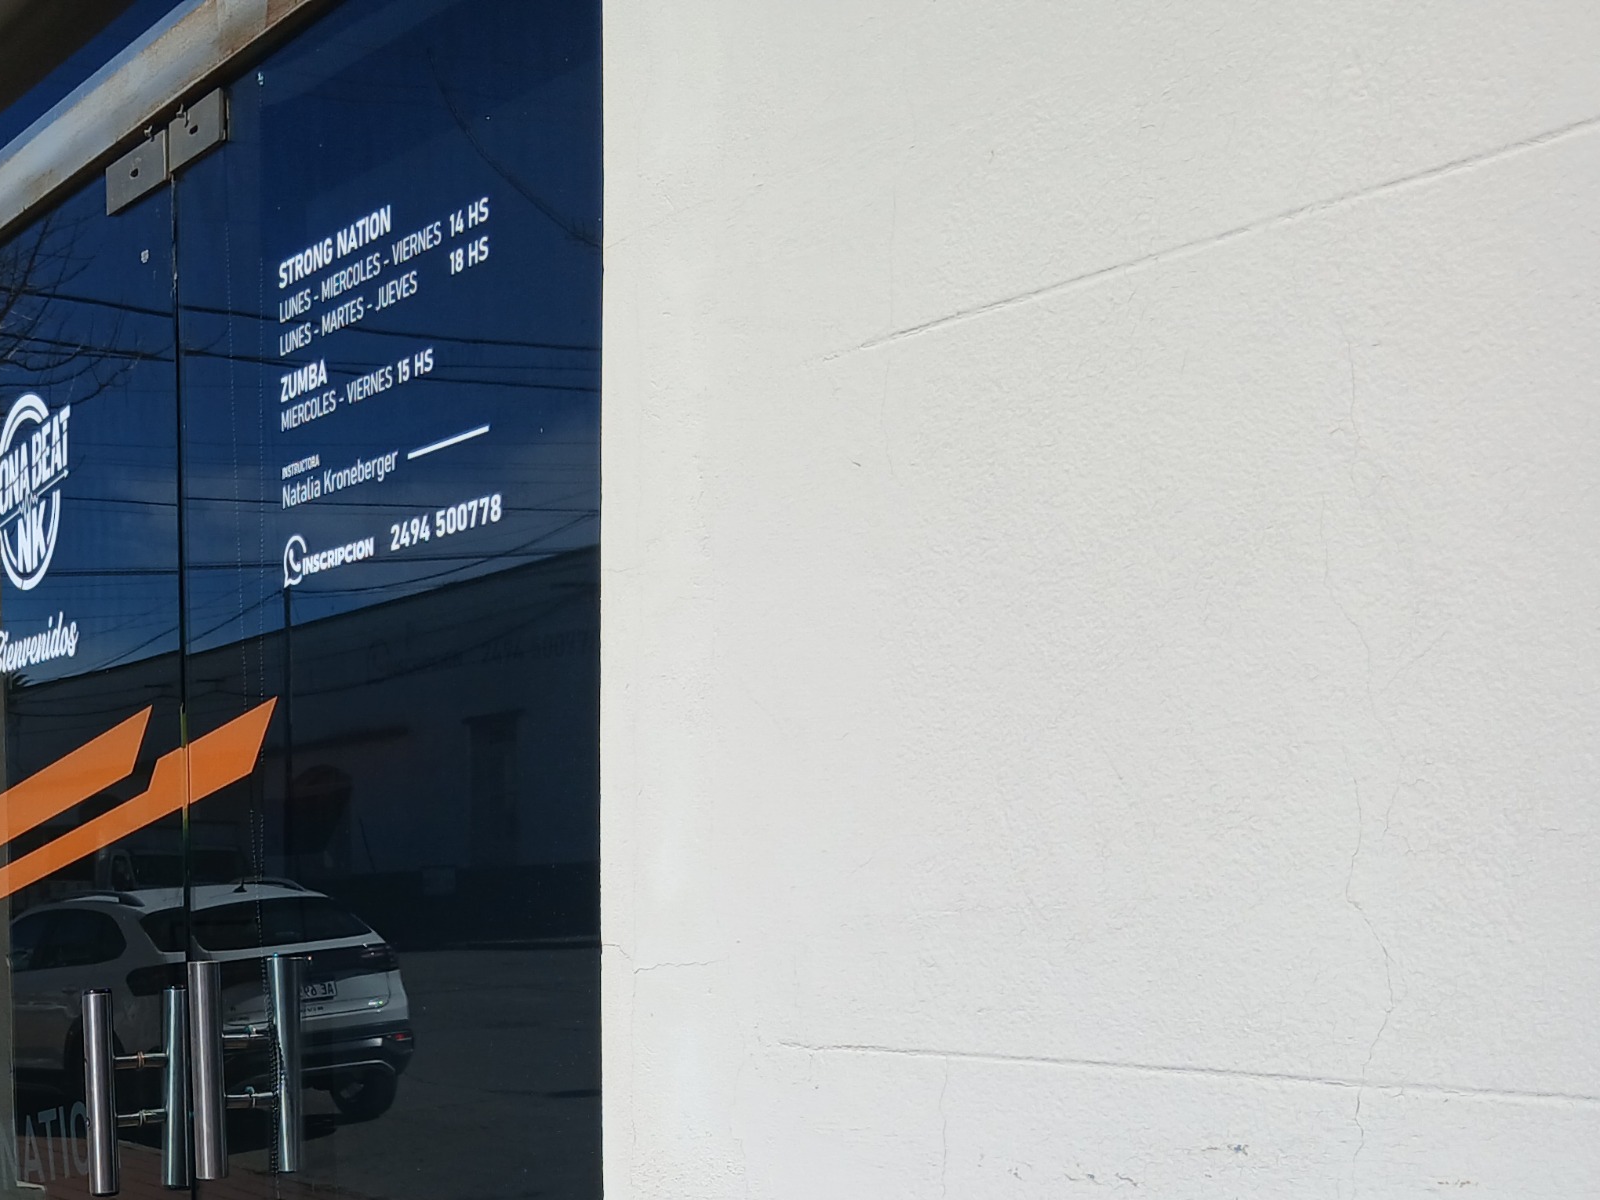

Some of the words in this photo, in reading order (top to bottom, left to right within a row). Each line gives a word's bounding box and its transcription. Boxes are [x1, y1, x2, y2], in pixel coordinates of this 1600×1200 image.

[278, 237, 333, 289] STRONG
[336, 204, 392, 259] NATION
[279, 288, 311, 324] LUNES
[321, 252, 381, 303] MIERCOLES
[391, 221, 442, 266] VIERNES
[449, 209, 464, 238] 14
[468, 196, 489, 229] HS
[279, 322, 312, 357] LUNES
[321, 296, 364, 337] MARTES
[375, 270, 418, 312] JUEVES
[449, 247, 463, 276] 18
[468, 235, 489, 267] HS
[280, 358, 328, 403] ZUMBA
[281, 389, 337, 432] MIERCOLES
[346, 366, 393, 405] VIERNES
[397, 359, 410, 384] 15
[414, 347, 434, 375] HS
[32, 404, 71, 488] BEAT
[282, 475, 321, 509] Natalia
[323, 449, 399, 496] Kroneberger
[302, 536, 375, 575] INSCRIPCION
[390, 515, 430, 551] 2494
[435, 493, 502, 538] 500778
[0, 1100, 92, 1191] NATIO
